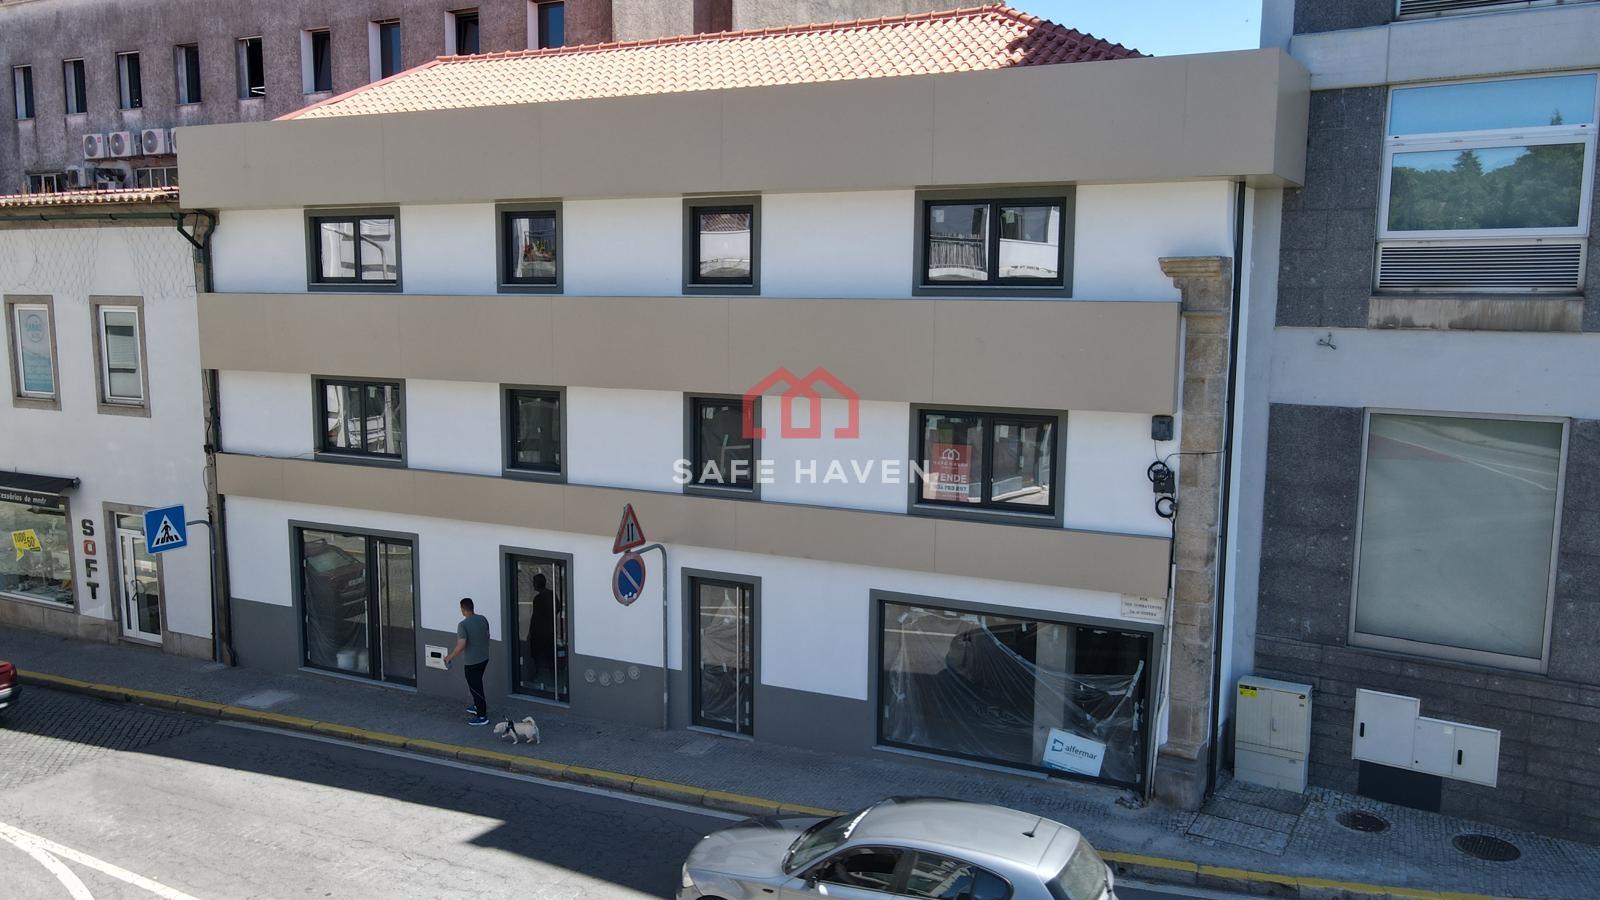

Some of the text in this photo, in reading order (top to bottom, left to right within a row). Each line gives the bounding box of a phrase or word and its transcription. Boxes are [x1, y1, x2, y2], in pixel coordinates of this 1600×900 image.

[930, 473, 968, 483] ENDE
[81, 519, 99, 599] SOFT
[1064, 744, 1098, 760] alfermar
